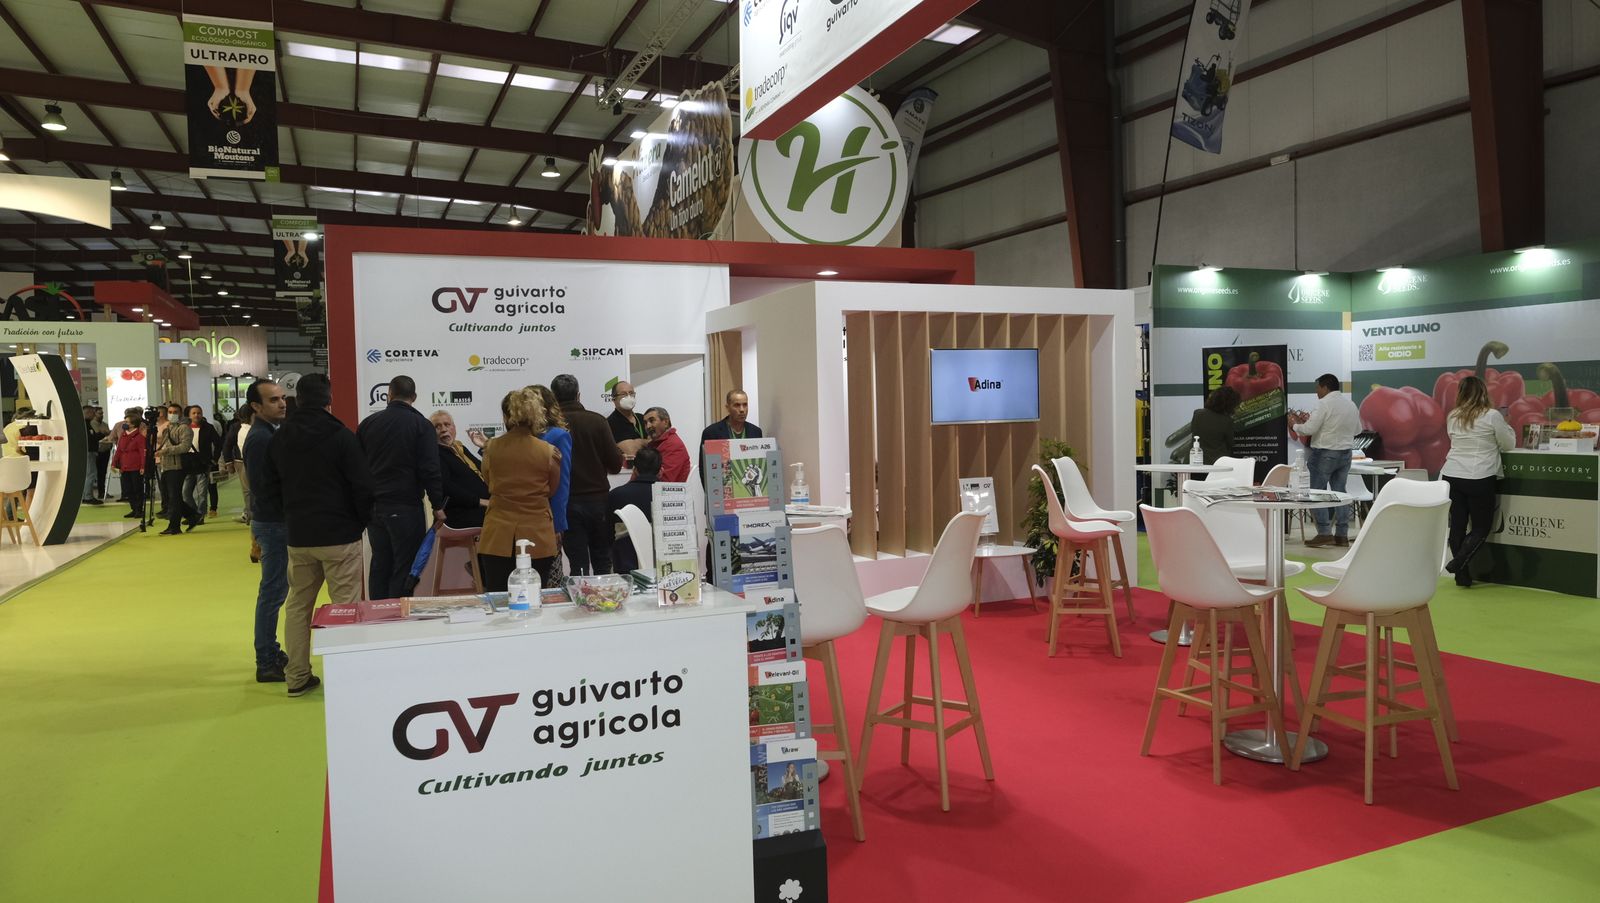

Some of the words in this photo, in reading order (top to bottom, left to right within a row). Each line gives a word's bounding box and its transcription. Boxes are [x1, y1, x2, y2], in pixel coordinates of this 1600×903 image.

[198, 26, 259, 40] COMPOST
[190, 49, 269, 65] ULTRAPRO
[207, 145, 260, 156] BioNatural
[213, 152, 256, 163] Moutons
[669, 143, 714, 208] Camelot
[494, 285, 566, 300] guivarto
[57, 329, 84, 338] futuro
[448, 322, 513, 333] Cultivando
[517, 322, 557, 334] juntos
[1362, 322, 1441, 338] VENTOLUNO
[385, 349, 439, 357] CORTEVA
[582, 347, 624, 356] SIPCAM
[482, 355, 526, 367] tradecorp
[974, 379, 1001, 390] Adina
[1529, 465, 1591, 474] DISCOVERY
[742, 521, 771, 529] TIMOREX
[1508, 514, 1566, 530] ORIGENE
[532, 670, 684, 717] guivarto
[417, 762, 569, 796] Cultivando
[580, 751, 665, 778] juntos
